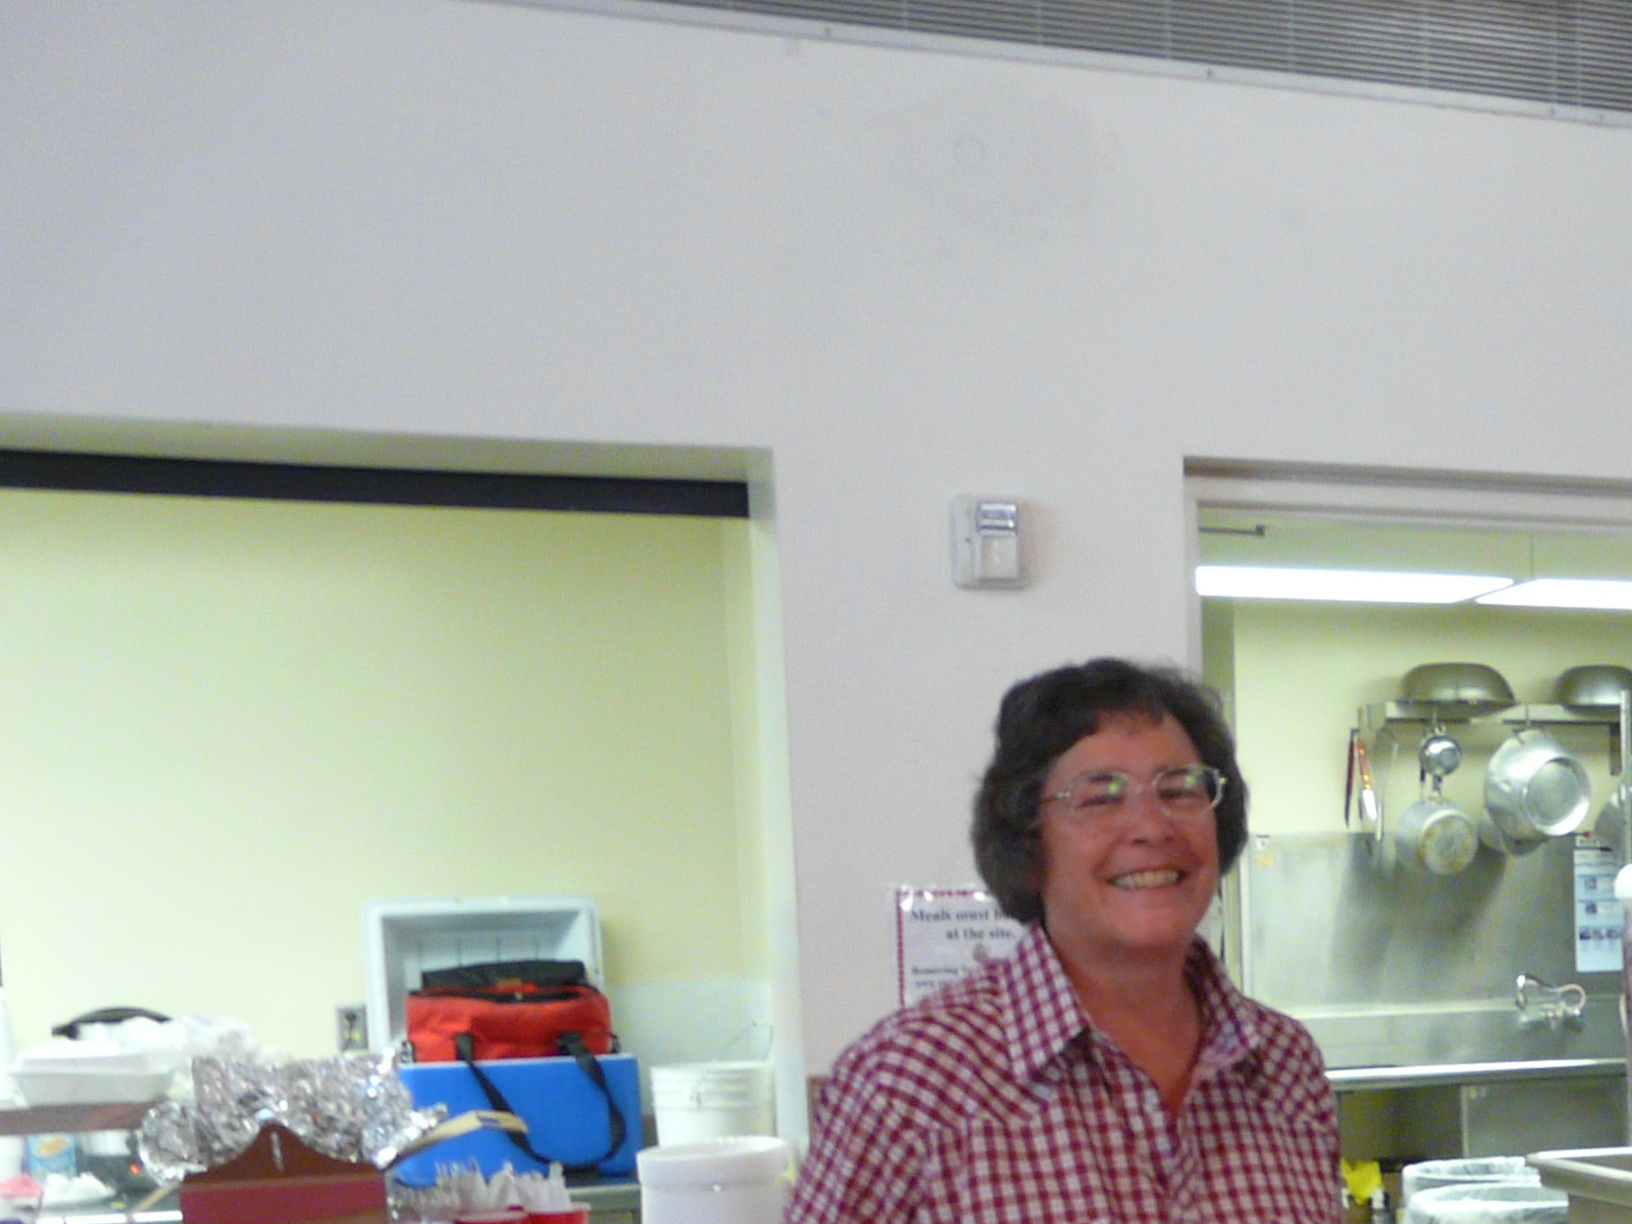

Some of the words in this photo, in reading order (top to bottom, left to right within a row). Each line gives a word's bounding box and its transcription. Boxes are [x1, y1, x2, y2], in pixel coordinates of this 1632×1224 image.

[911, 908, 951, 921] Meals
[956, 909, 989, 920] must
[946, 929, 959, 940] at
[963, 928, 984, 940] the
